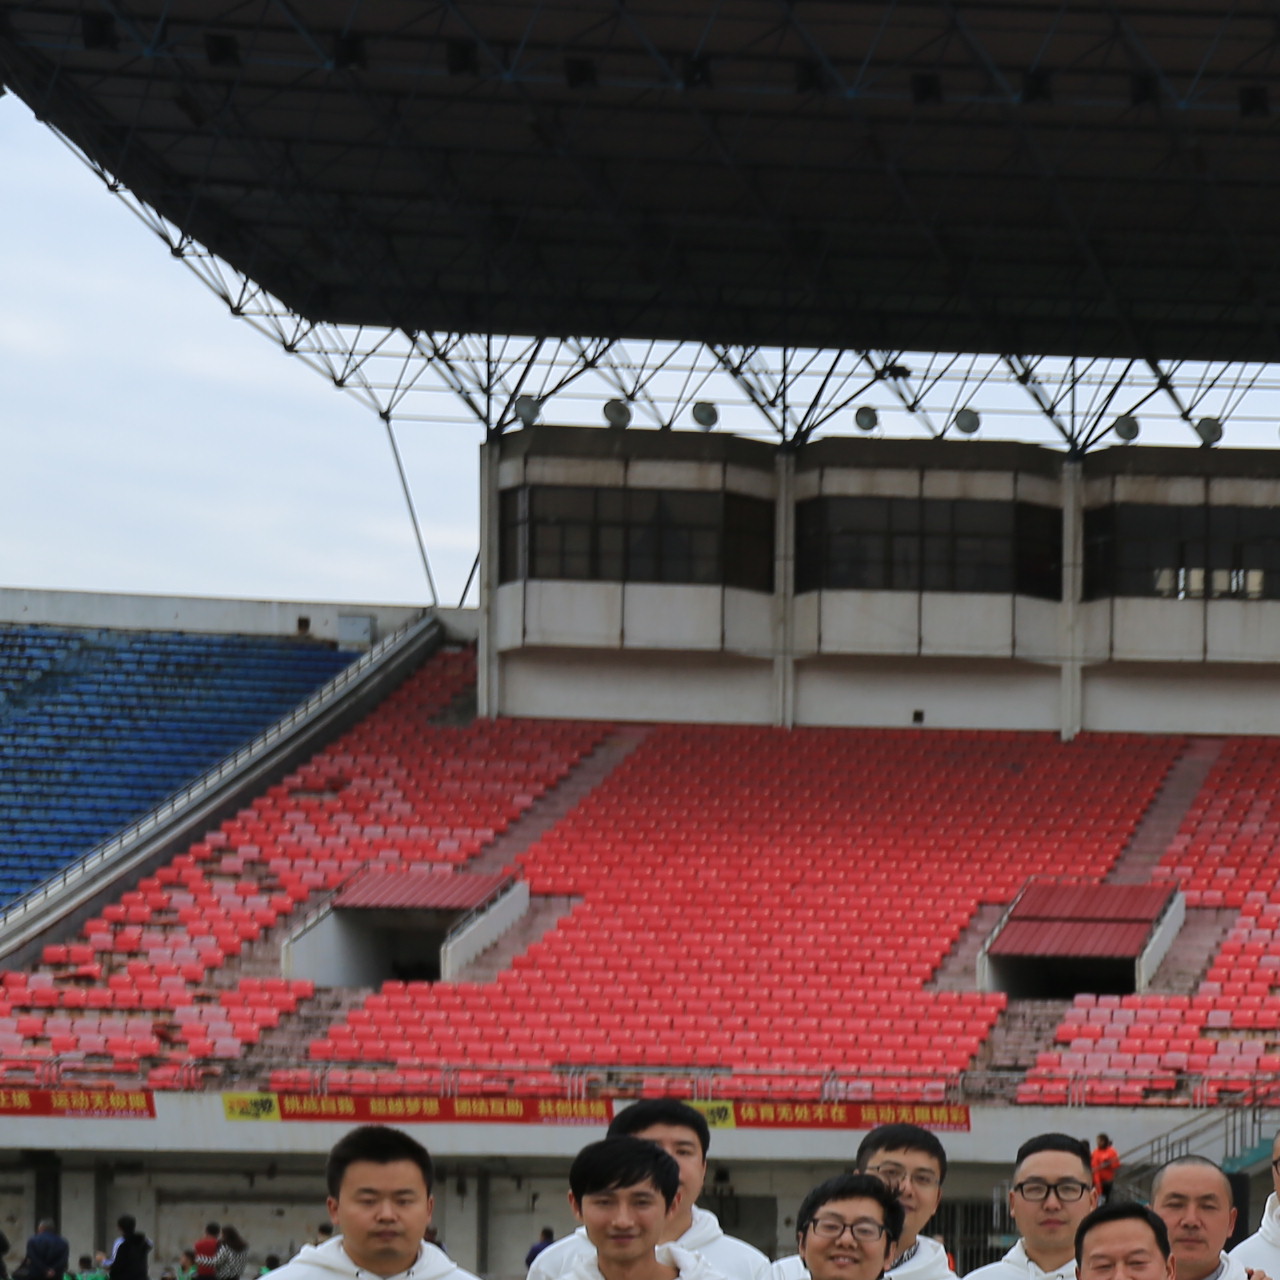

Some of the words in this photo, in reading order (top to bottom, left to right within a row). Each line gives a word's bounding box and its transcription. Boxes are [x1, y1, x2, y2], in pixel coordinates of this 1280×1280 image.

[741, 1102, 848, 1123] 体育无处不在
